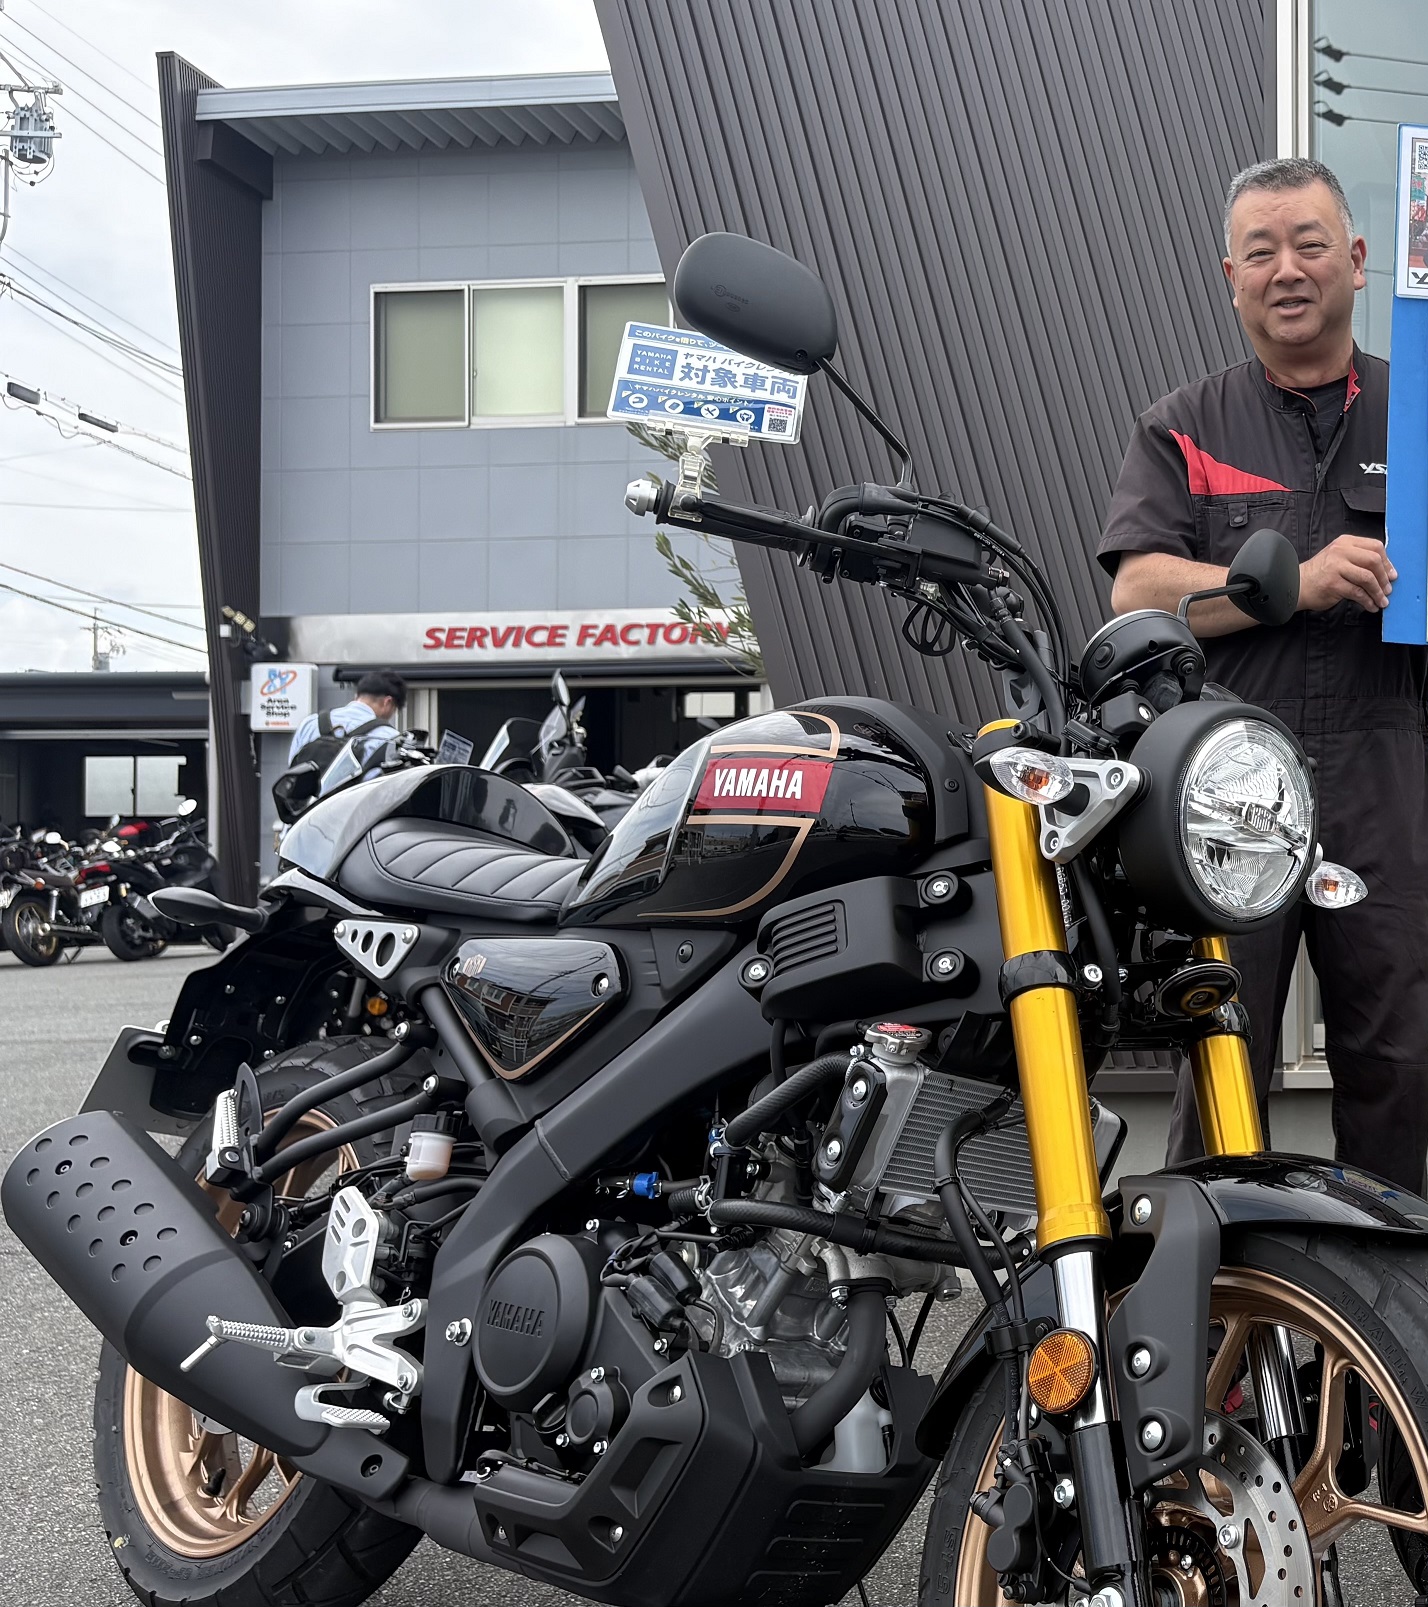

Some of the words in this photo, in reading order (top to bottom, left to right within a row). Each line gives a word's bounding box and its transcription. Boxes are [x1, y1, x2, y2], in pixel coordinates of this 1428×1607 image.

[637, 349, 672, 360] YAMAHA
[683, 352, 717, 364] ヤマハ
[633, 364, 669, 375] RENTAL
[679, 362, 799, 400] 対象車両
[423, 624, 570, 650] SERVICE
[713, 768, 803, 799] YAMAHA
[486, 1299, 546, 1338] YAMAHA
